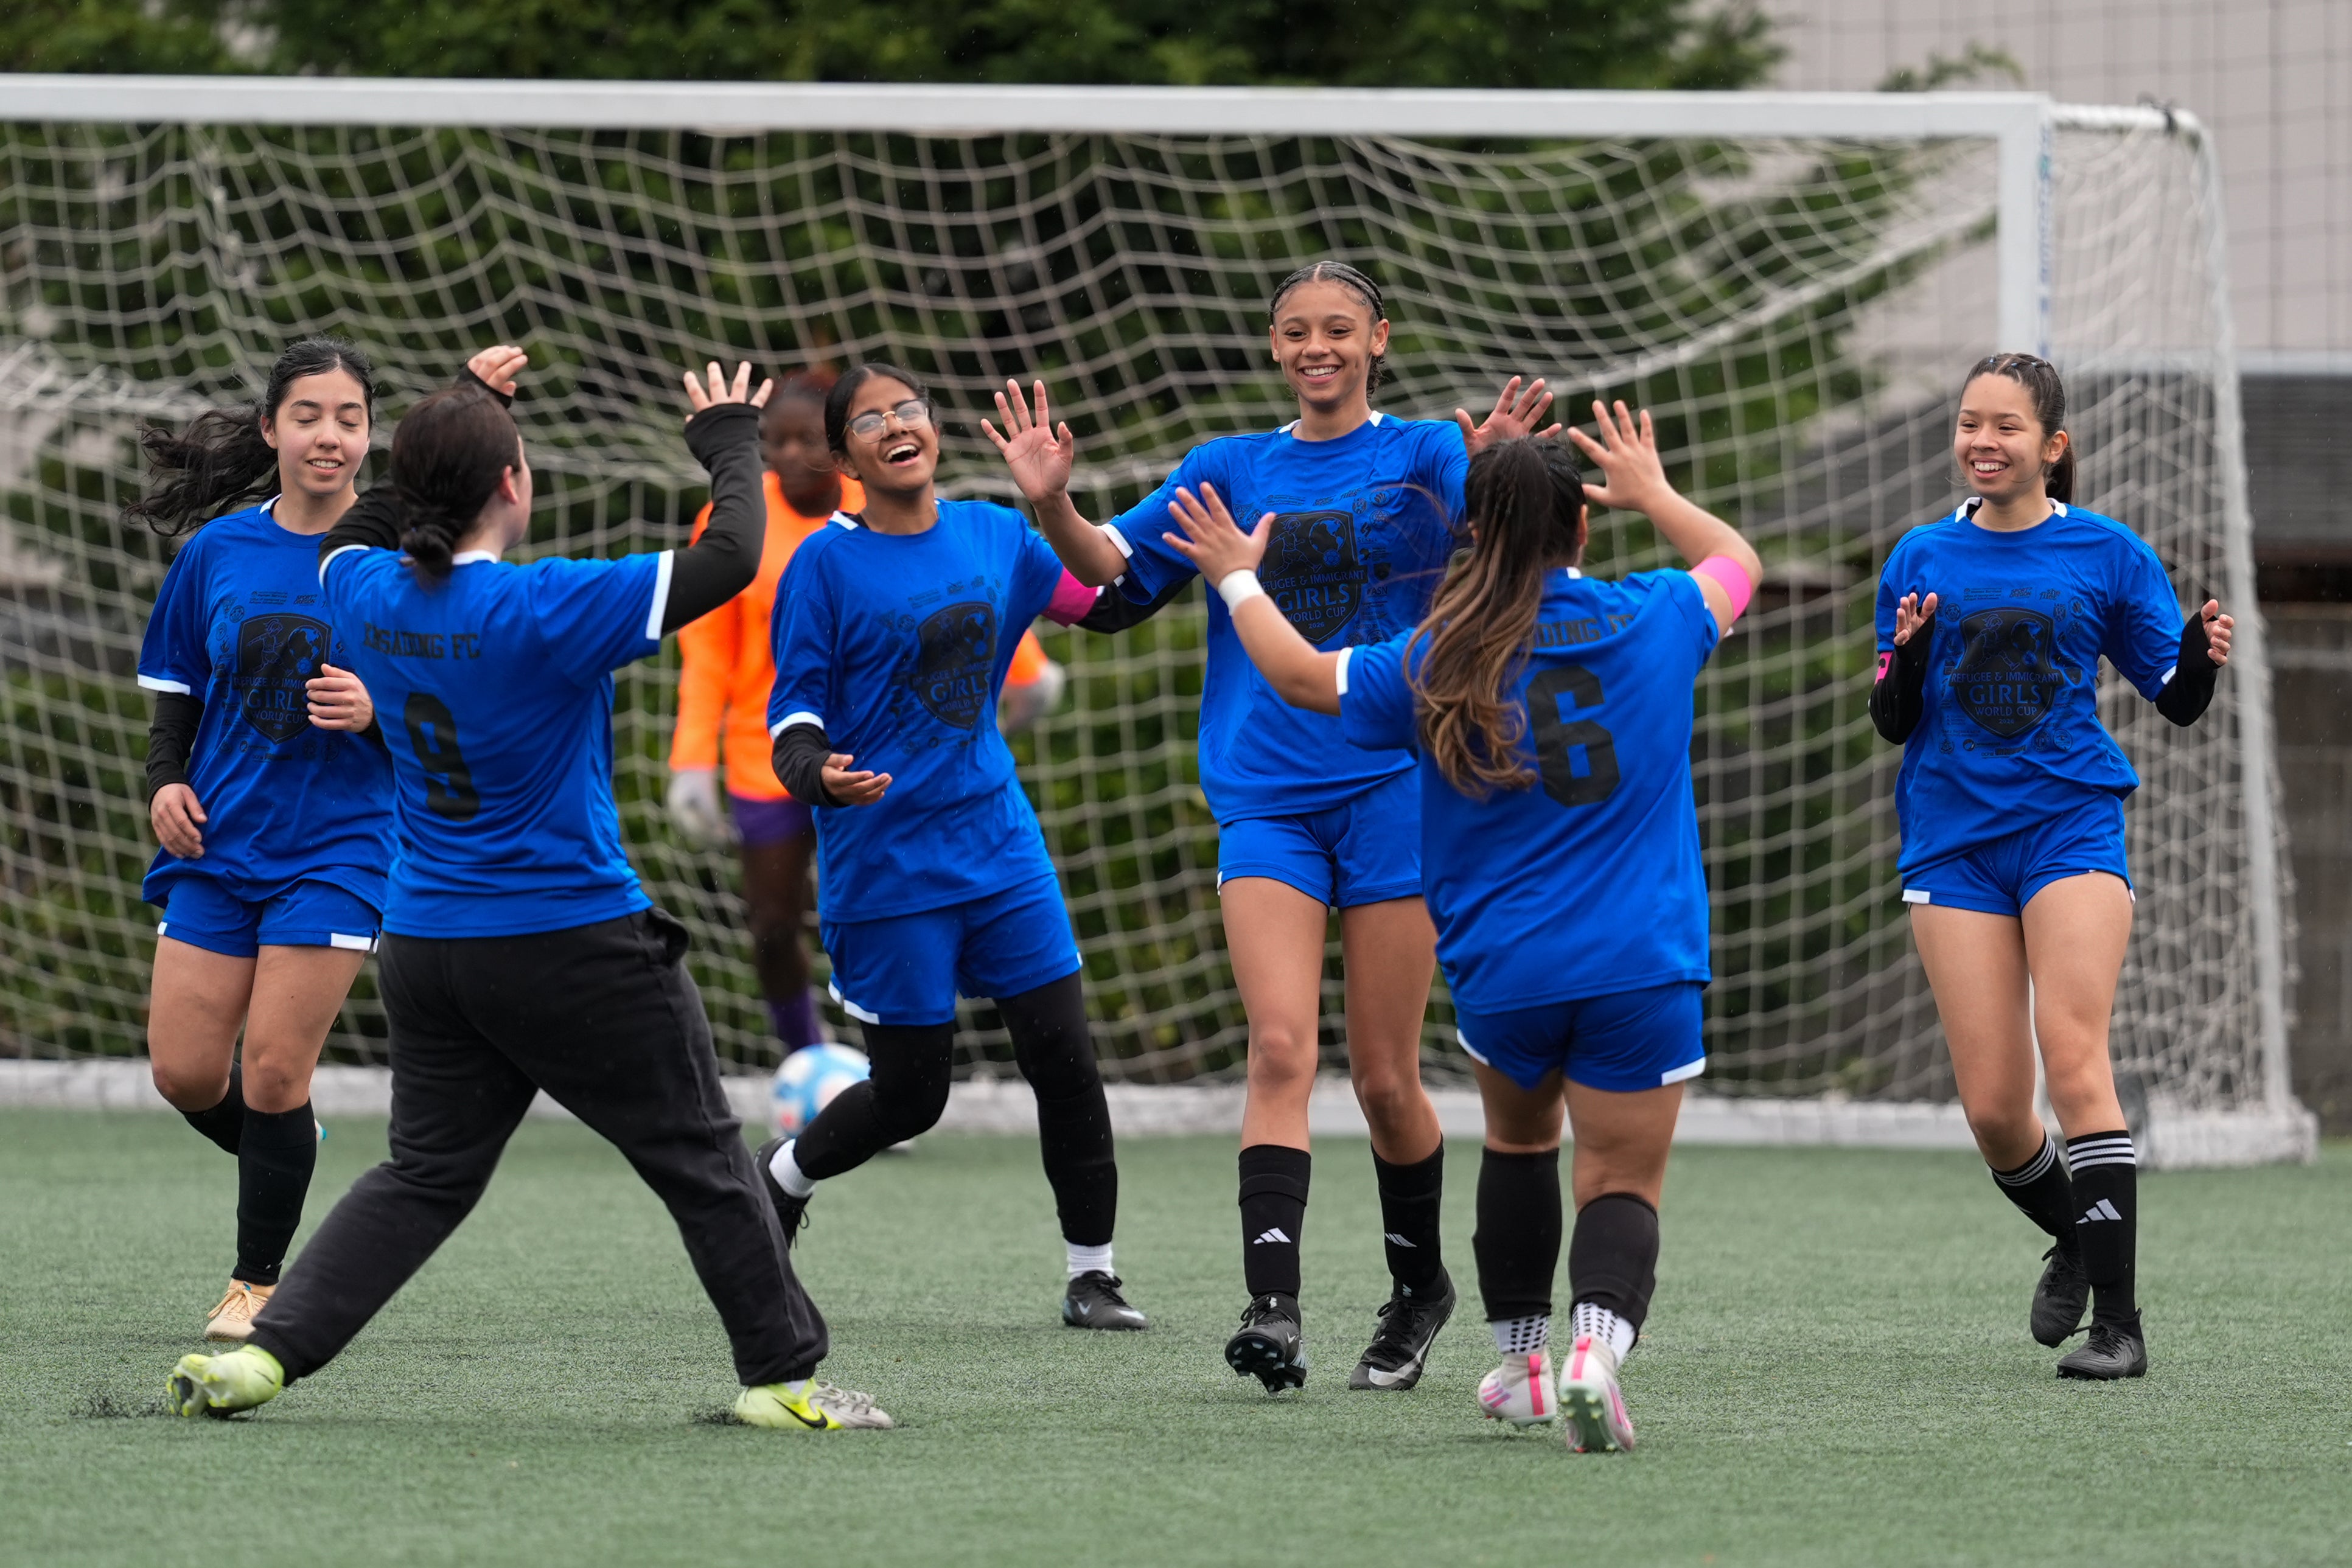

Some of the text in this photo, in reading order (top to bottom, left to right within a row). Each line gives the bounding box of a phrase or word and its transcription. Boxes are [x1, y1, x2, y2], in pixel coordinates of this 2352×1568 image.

[1262, 570, 1364, 591] EFUGEE & IMMIGRANT
[1275, 584, 1350, 612] GIRLS
[1325, 606, 1346, 618] CUP
[1534, 618, 1601, 648] DING
[452, 633, 481, 660] FC
[1951, 672, 2060, 683] REFUGEE & IMMIGRANT
[1969, 684, 2042, 705] GIRLS
[1975, 706, 2038, 716] WORLD CUP
[1526, 664, 1621, 808] 6
[403, 692, 481, 822] 9
